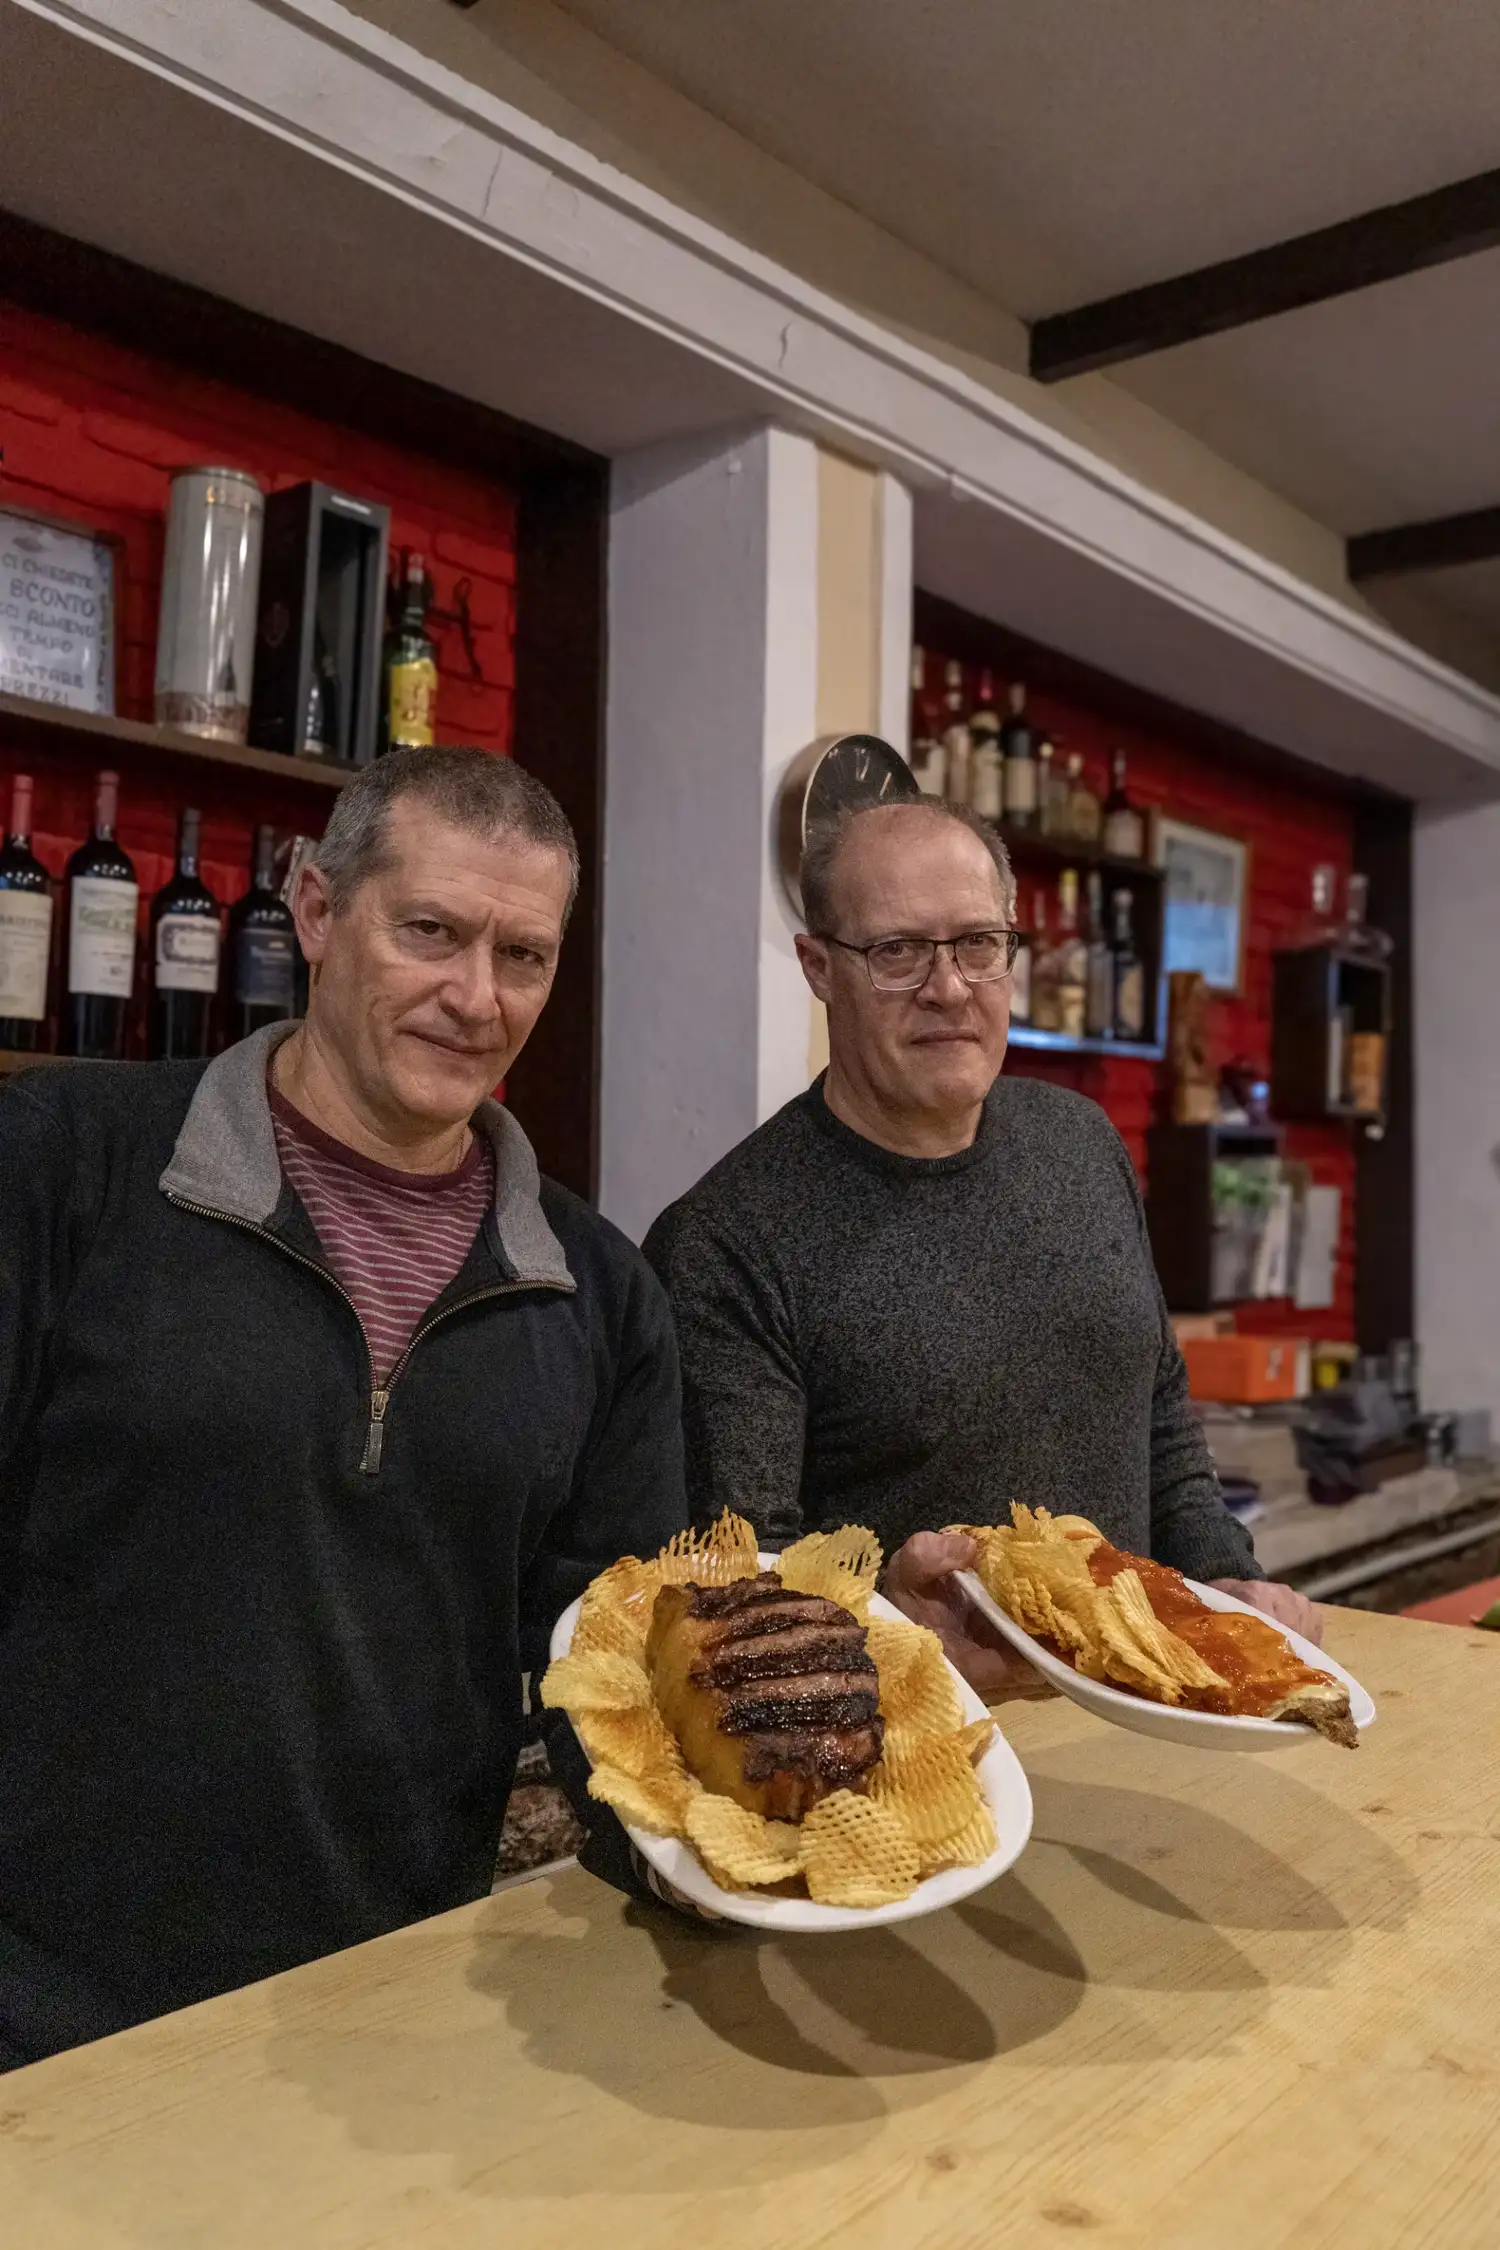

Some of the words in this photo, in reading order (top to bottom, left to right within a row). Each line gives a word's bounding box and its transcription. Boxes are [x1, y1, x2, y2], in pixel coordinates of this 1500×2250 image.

[10, 578, 96, 618] SCONTO
[9, 625, 74, 653] TEMPO
[4, 660, 84, 688] ENTARE
